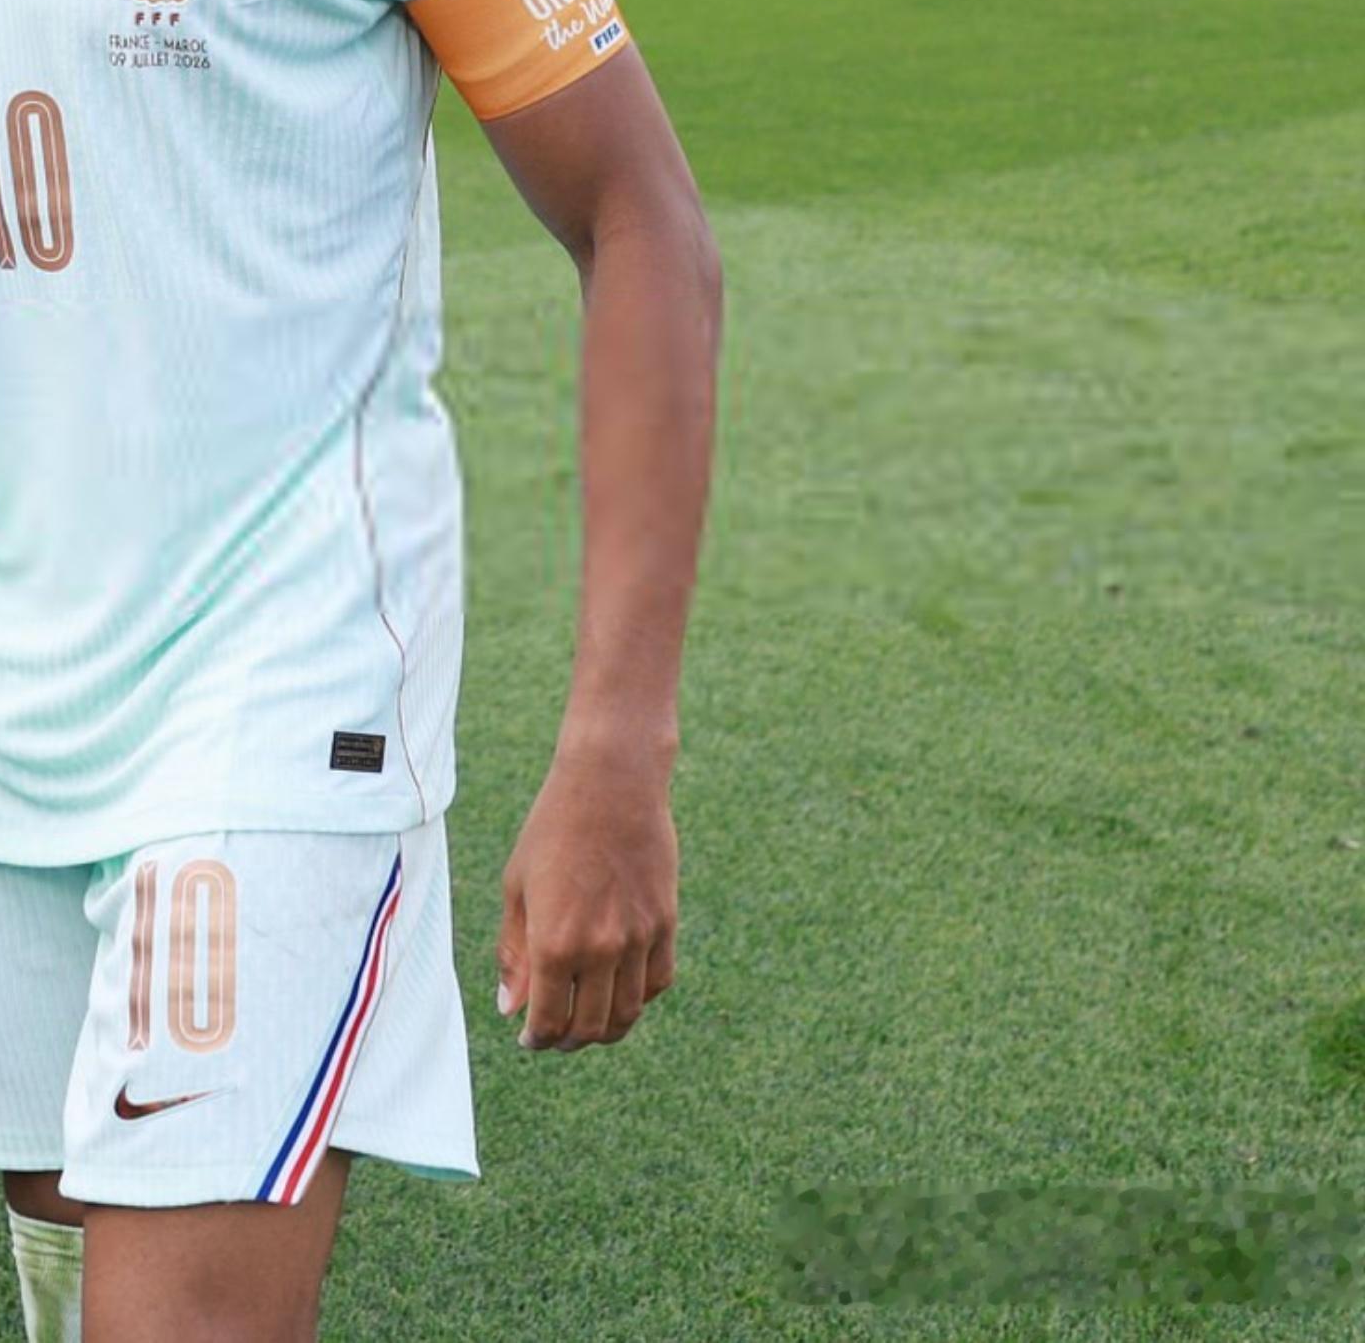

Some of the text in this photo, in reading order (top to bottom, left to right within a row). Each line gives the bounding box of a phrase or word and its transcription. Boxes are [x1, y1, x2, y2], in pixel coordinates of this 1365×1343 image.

[109, 34, 150, 50] FRANCE
[163, 38, 208, 53] MAROC
[539, 18, 585, 50] the
[109, 52, 127, 67] 09
[173, 52, 211, 69] 2026
[126, 859, 237, 1053] 10
